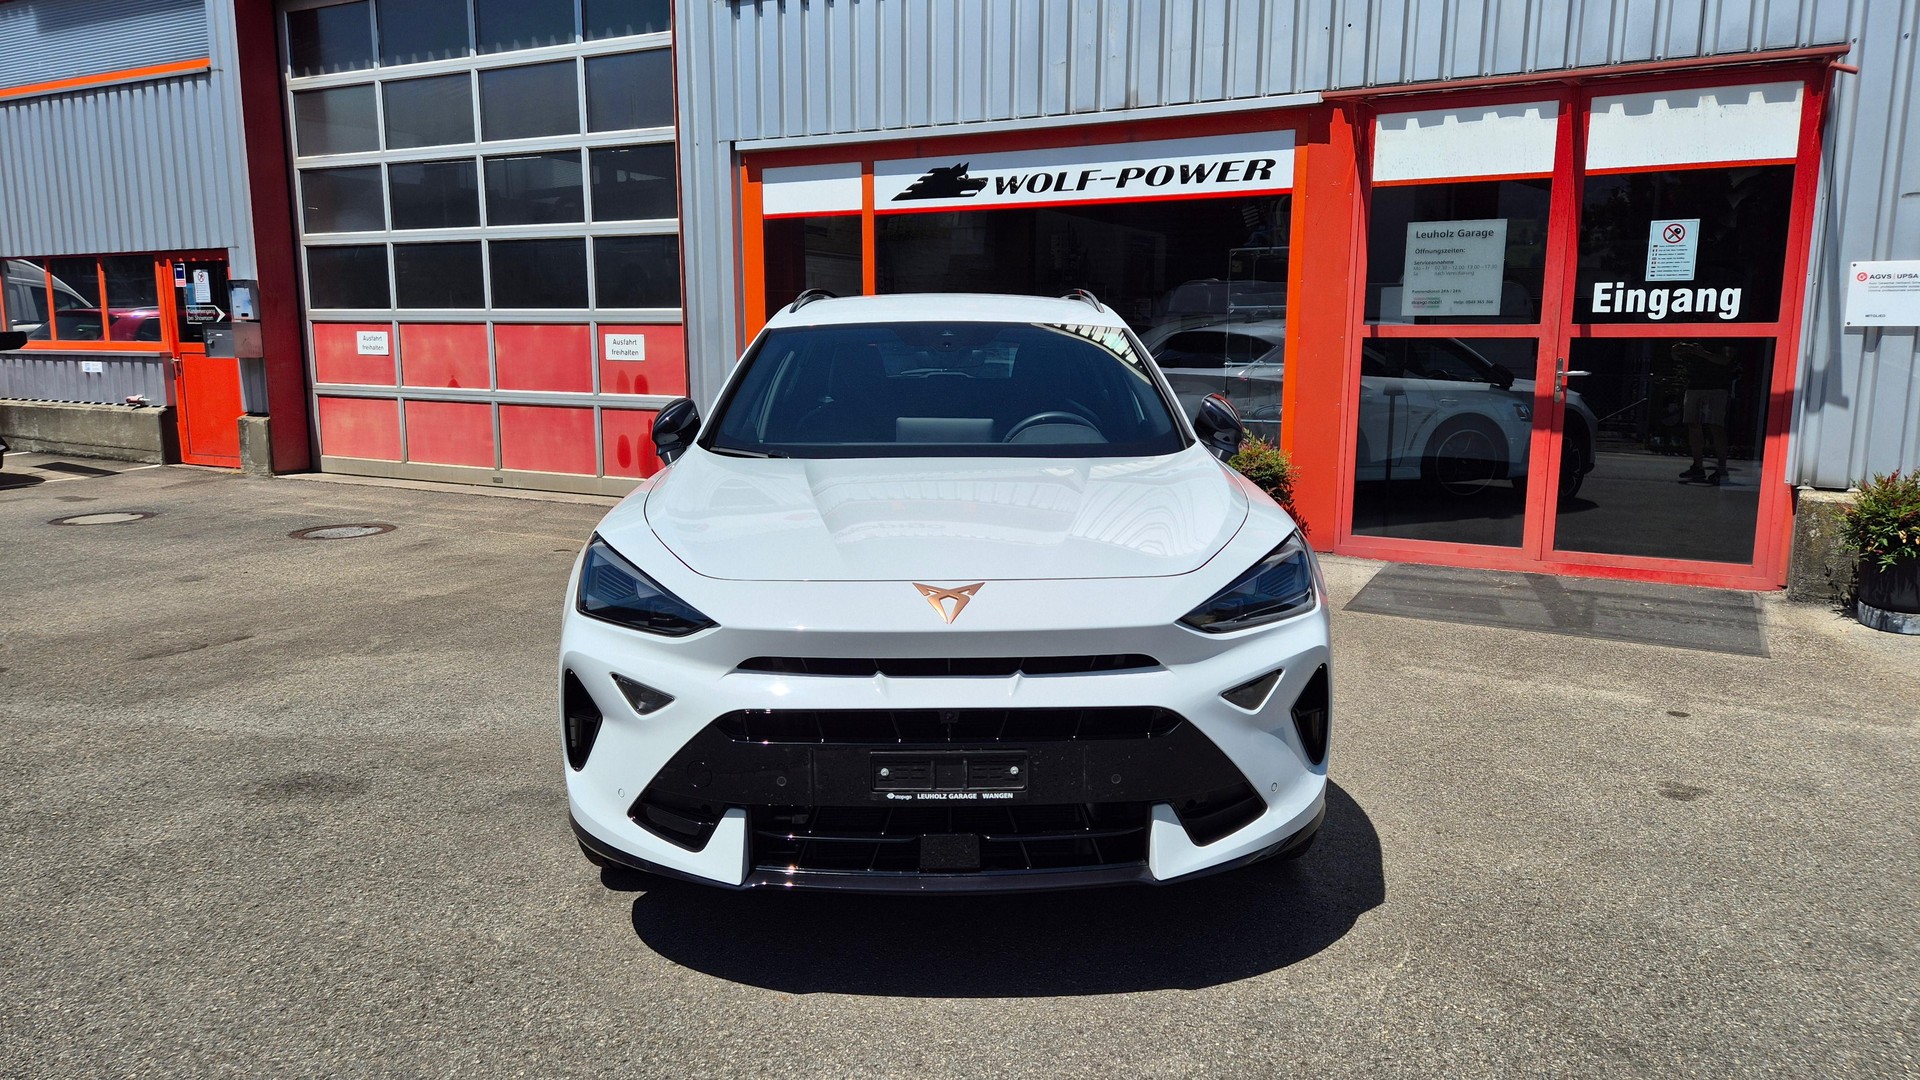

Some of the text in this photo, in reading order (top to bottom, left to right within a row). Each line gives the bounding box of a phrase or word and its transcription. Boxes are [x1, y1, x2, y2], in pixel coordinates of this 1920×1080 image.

[995, 158, 1277, 196] WOLF-POWER
[1416, 228, 1495, 239] Leuholz Garage
[1592, 282, 1742, 320] Eingang
